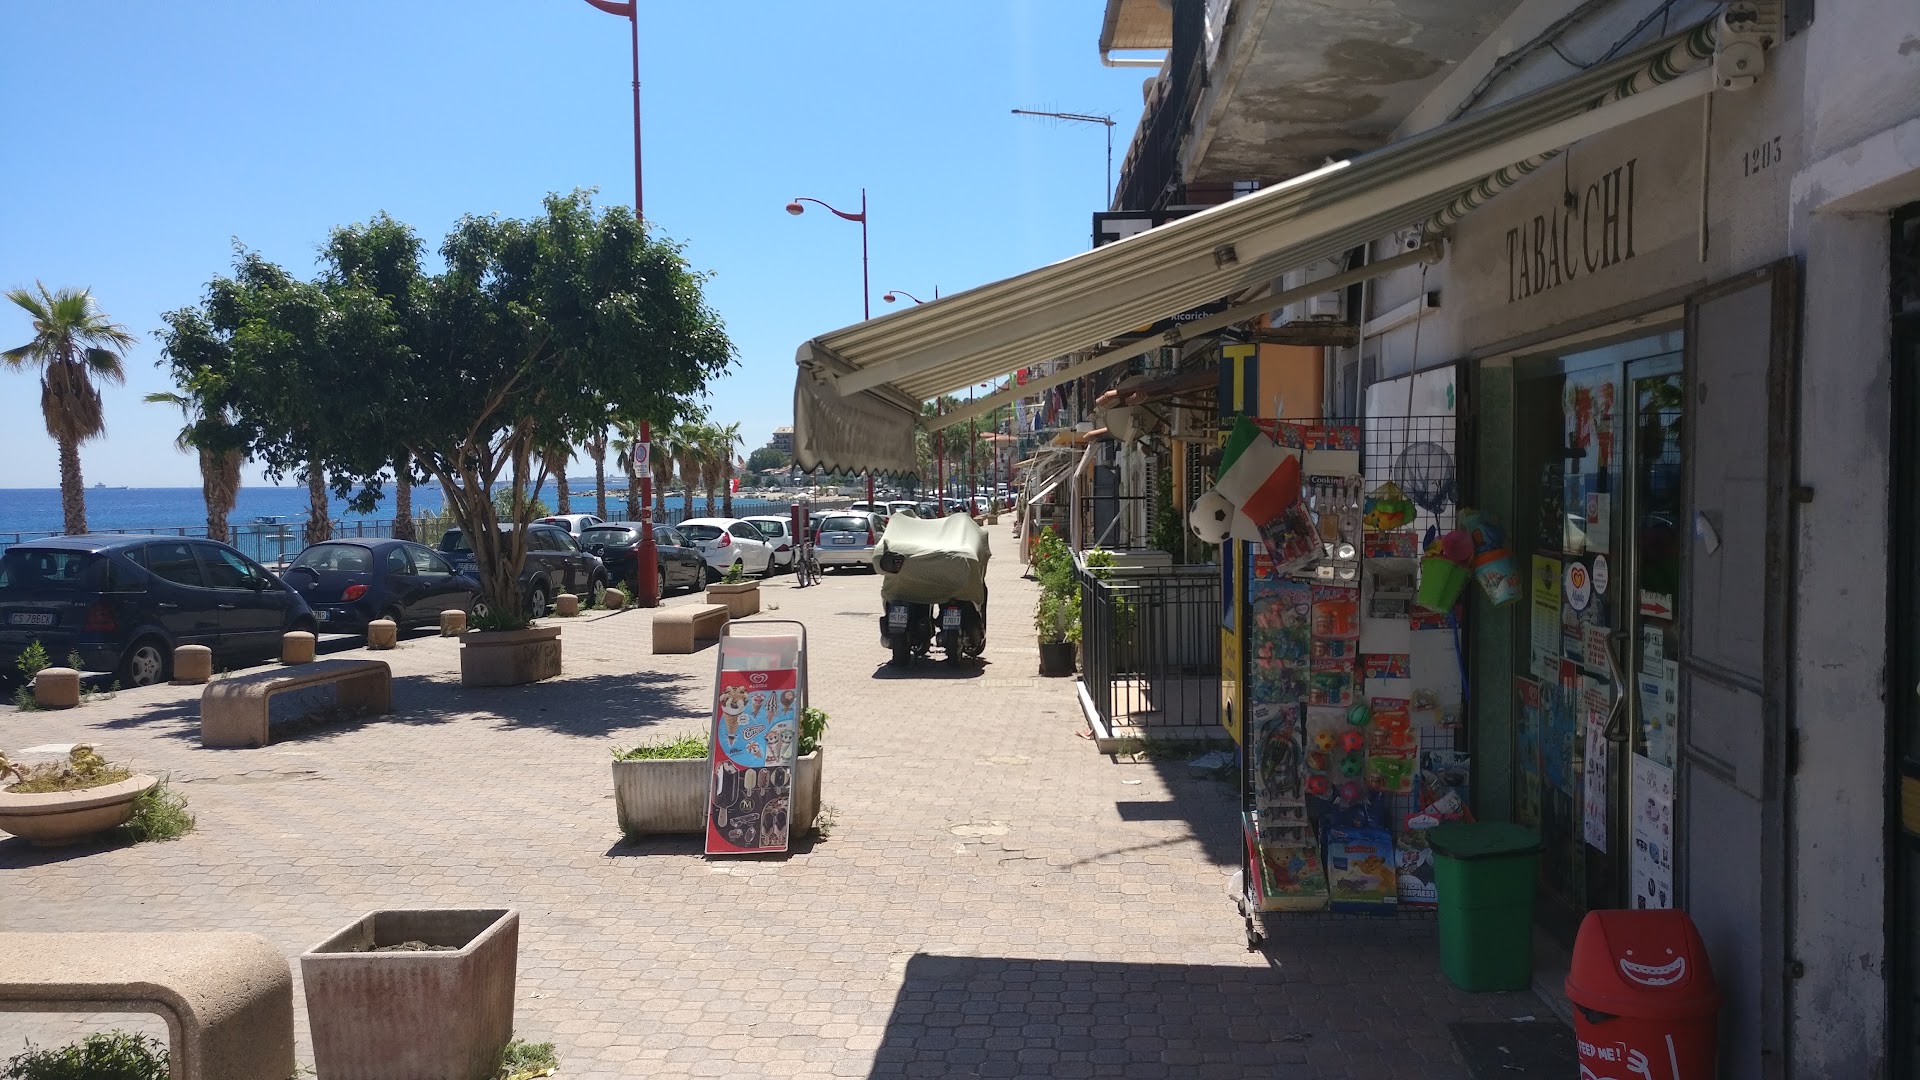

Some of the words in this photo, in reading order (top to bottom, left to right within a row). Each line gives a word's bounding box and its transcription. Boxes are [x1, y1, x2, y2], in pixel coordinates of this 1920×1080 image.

[1743, 135, 1783, 178] 1203
[1506, 157, 1638, 303] TABACCHI
[1222, 344, 1256, 411] T
[1222, 416, 1238, 427] AUTO
[1311, 476, 1344, 486] Cooking
[1578, 1040, 1596, 1057] FEED
[1597, 1047, 1622, 1062] ME!
